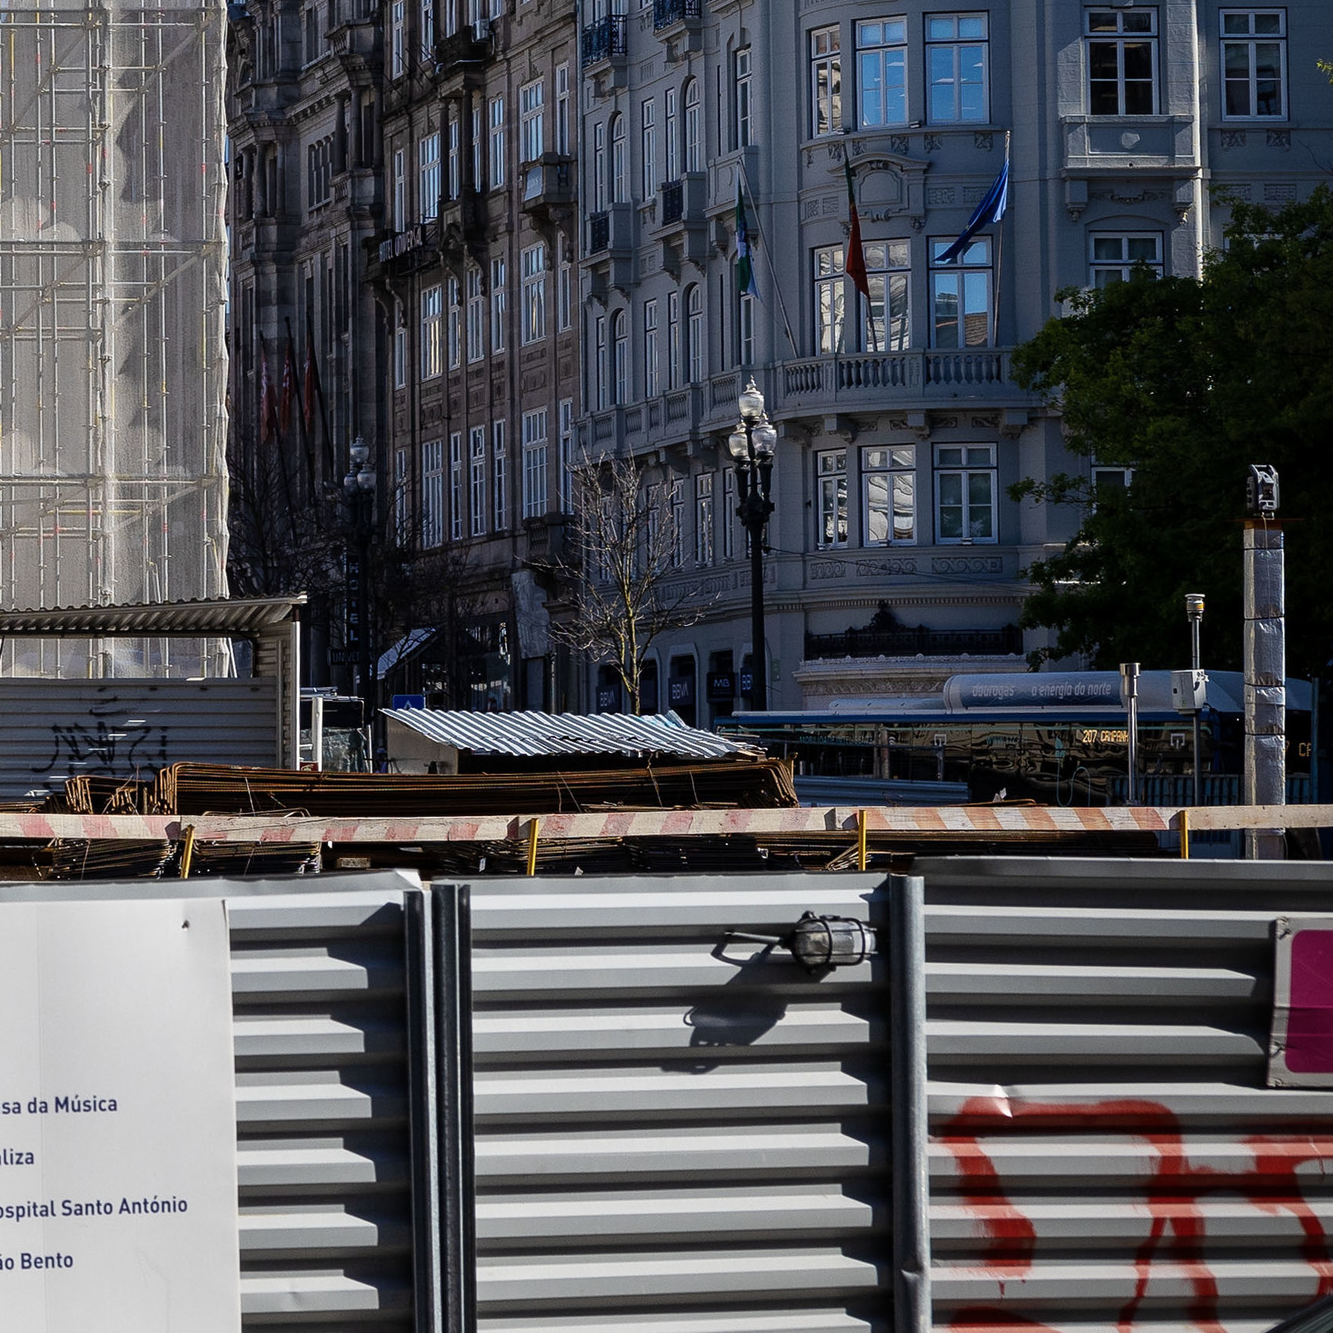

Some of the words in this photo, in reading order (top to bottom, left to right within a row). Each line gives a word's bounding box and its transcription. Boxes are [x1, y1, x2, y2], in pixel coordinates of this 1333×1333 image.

[348, 562, 359, 641] HOTEL
[672, 681, 689, 700] BBVA
[713, 678, 730, 688] MB
[1039, 681, 1072, 700] energia
[1074, 681, 1086, 696] do
[1088, 682, 1112, 696] norte
[1082, 729, 1097, 743] 207
[1100, 730, 1129, 743] CAMPANH
[27, 1096, 49, 1114] da
[54, 1093, 118, 1113] Música
[60, 1199, 113, 1217] Santo
[118, 1194, 189, 1216] António
[21, 1250, 75, 1270] Bento
